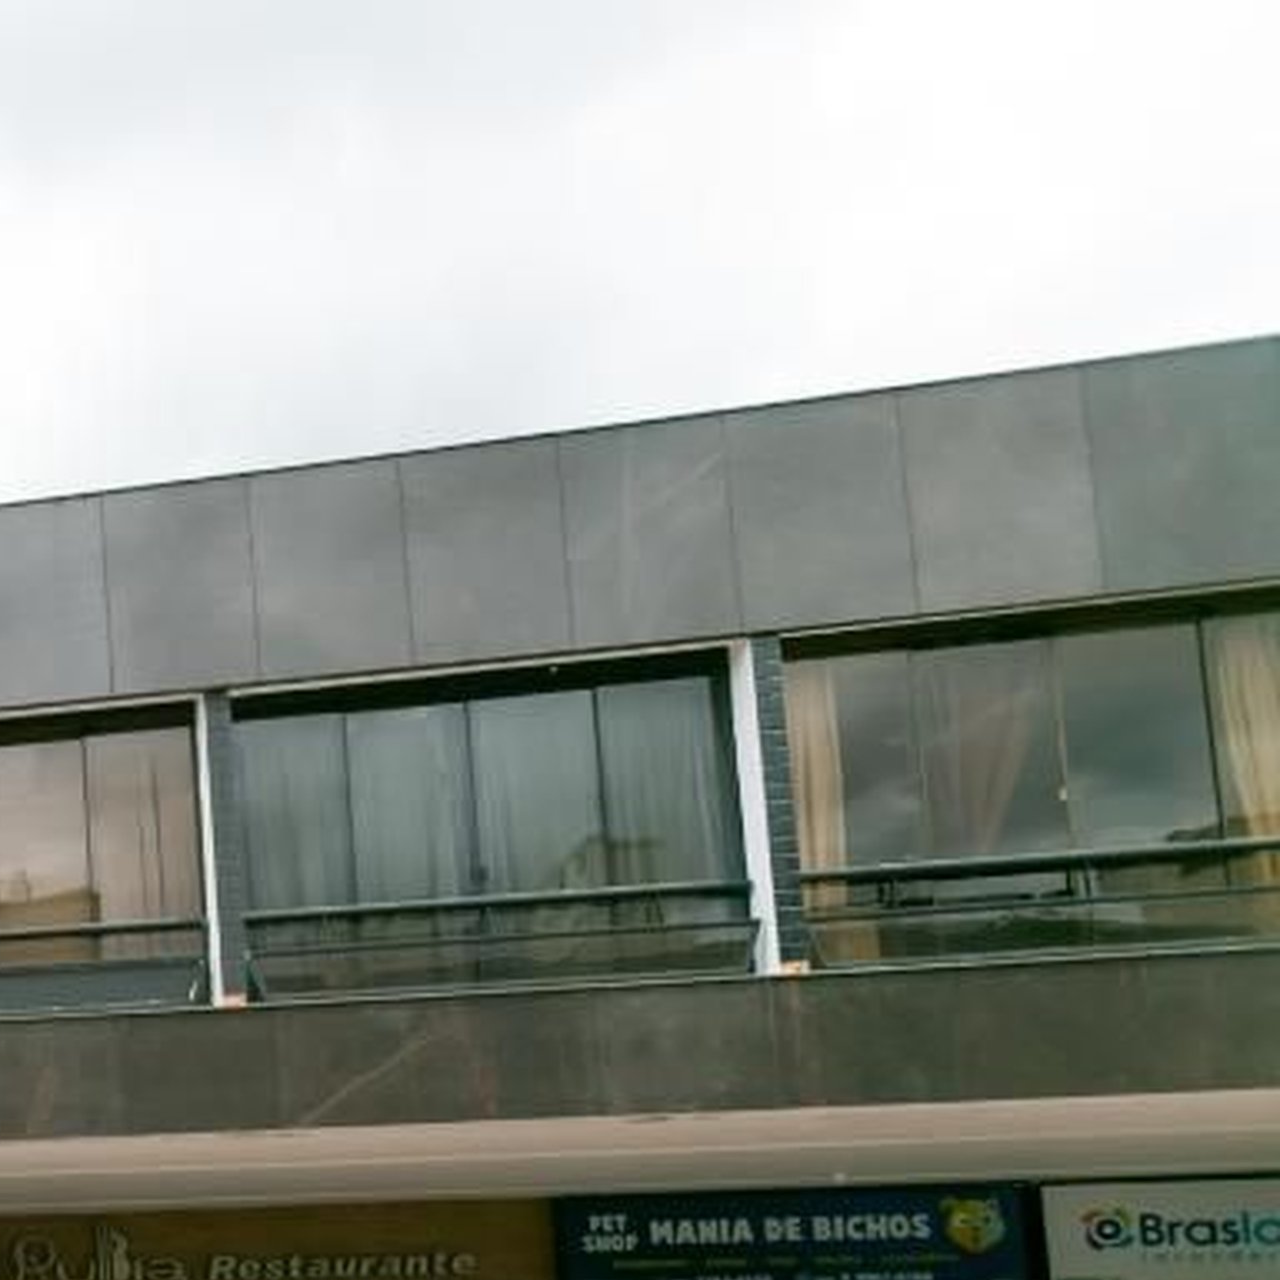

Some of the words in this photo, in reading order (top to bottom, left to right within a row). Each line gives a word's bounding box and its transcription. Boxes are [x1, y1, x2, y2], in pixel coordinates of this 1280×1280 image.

[588, 1215, 627, 1232] PET
[648, 1218, 754, 1246] MANIA
[764, 1216, 802, 1243] DE
[811, 1213, 931, 1242] BICHOS
[582, 1235, 637, 1252] SHOP
[209, 1251, 478, 1280] Restaurante
